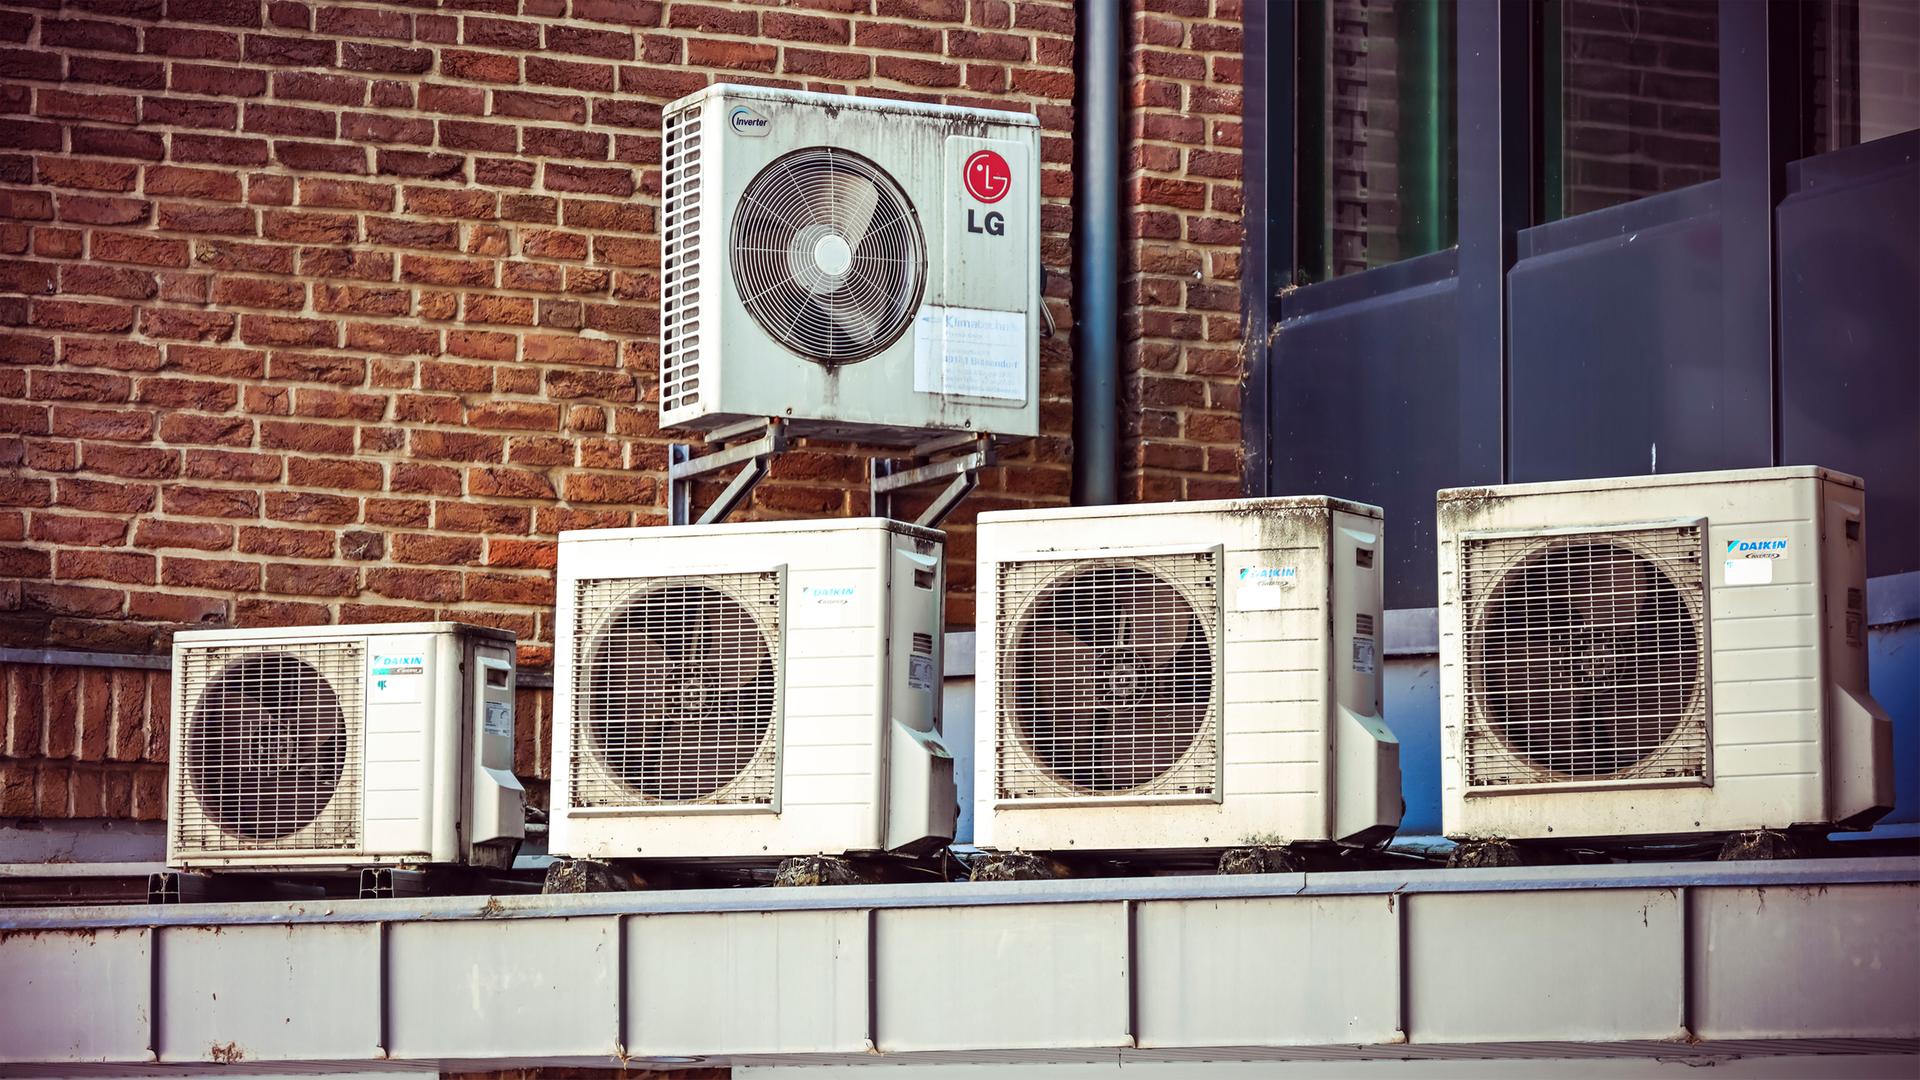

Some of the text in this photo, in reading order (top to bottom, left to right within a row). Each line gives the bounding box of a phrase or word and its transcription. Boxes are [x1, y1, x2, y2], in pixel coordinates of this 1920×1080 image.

[967, 208, 1005, 236] LG
[1739, 540, 1787, 551] DAIKIN
[383, 656, 422, 665] DAIKIN
